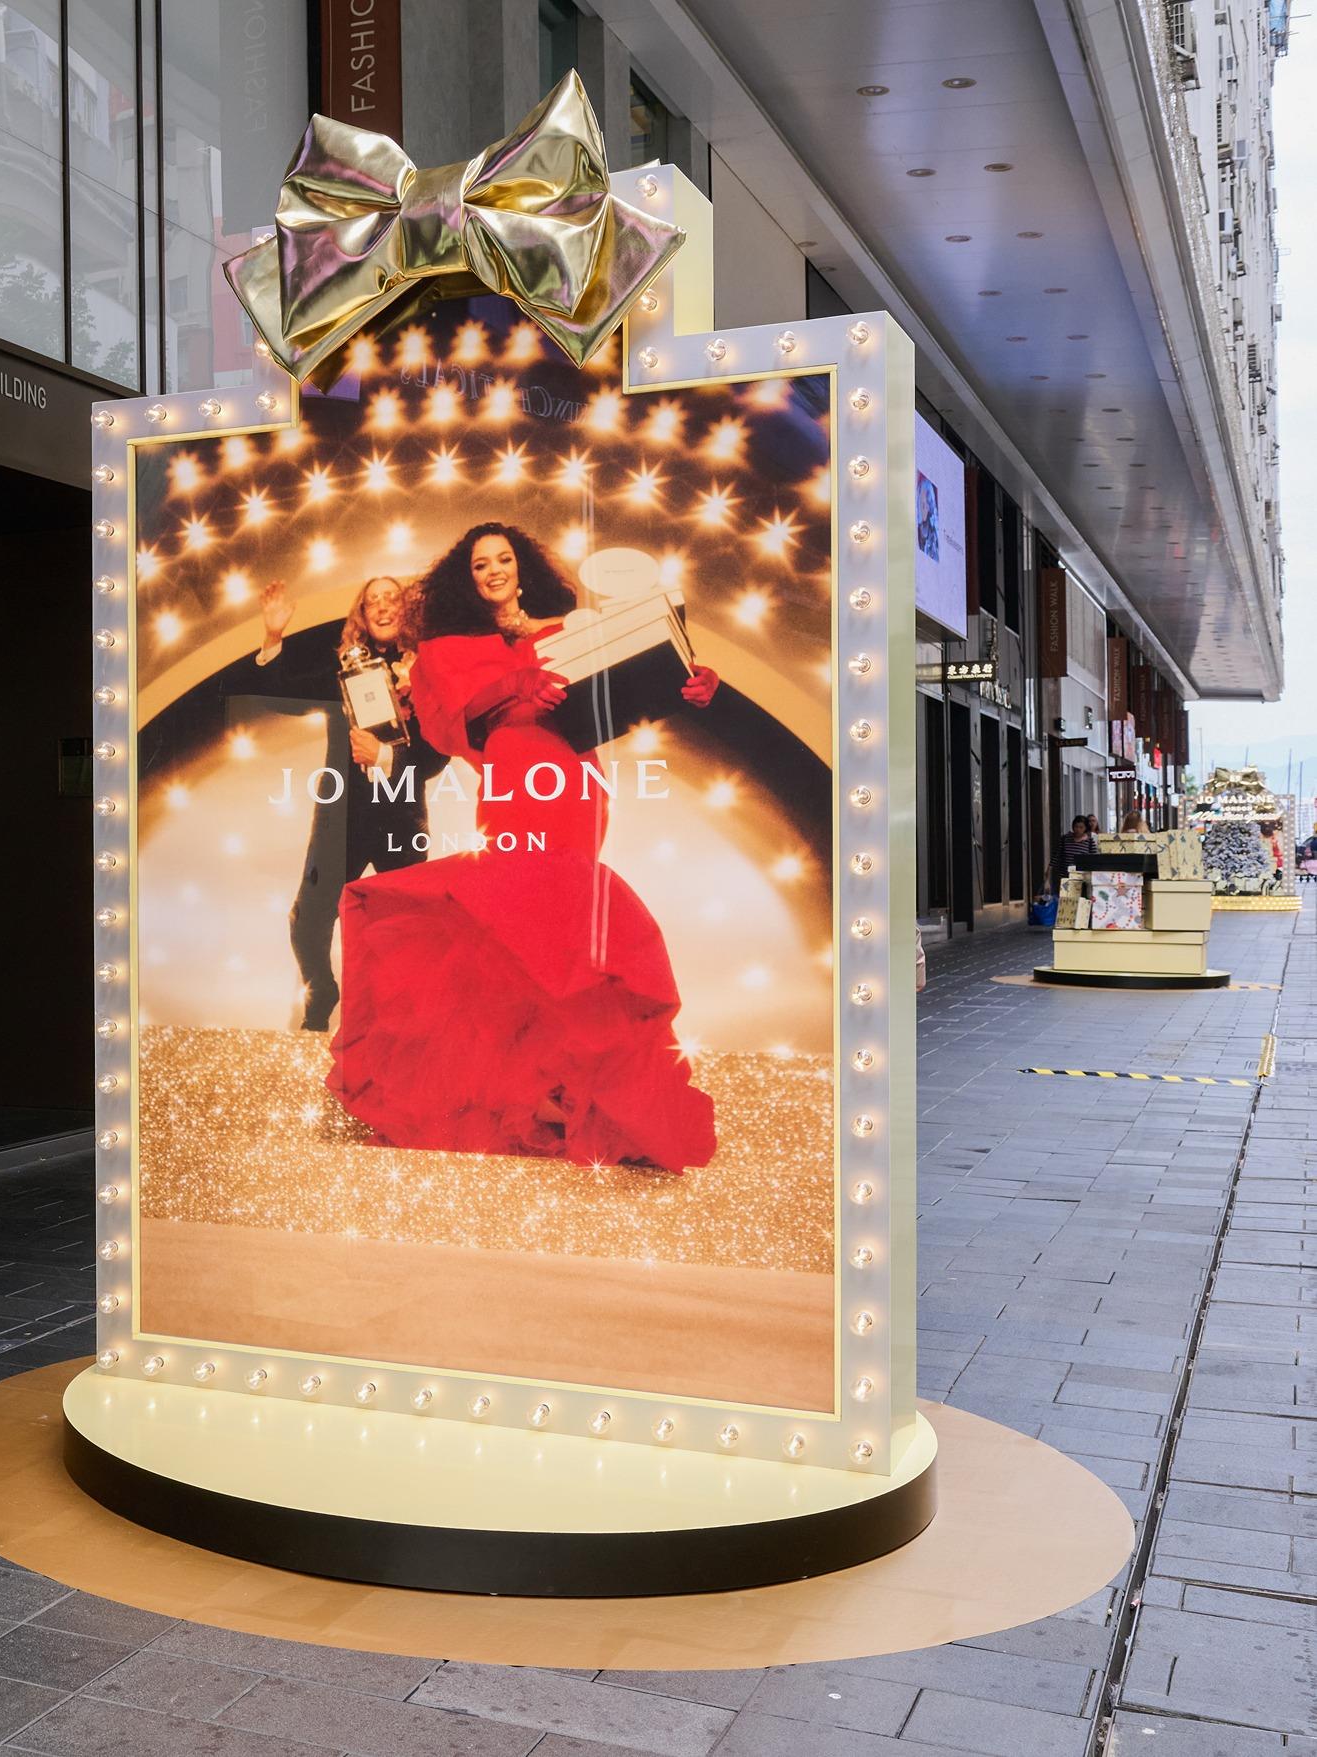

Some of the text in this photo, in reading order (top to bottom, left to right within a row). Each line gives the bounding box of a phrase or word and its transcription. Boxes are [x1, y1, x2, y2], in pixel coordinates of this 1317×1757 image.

[1049, 580, 1059, 652] FASHION WALK
[268, 760, 671, 805] JO MALONE
[1196, 794, 1275, 804] JO MALONE
[387, 831, 547, 853] LONDON
